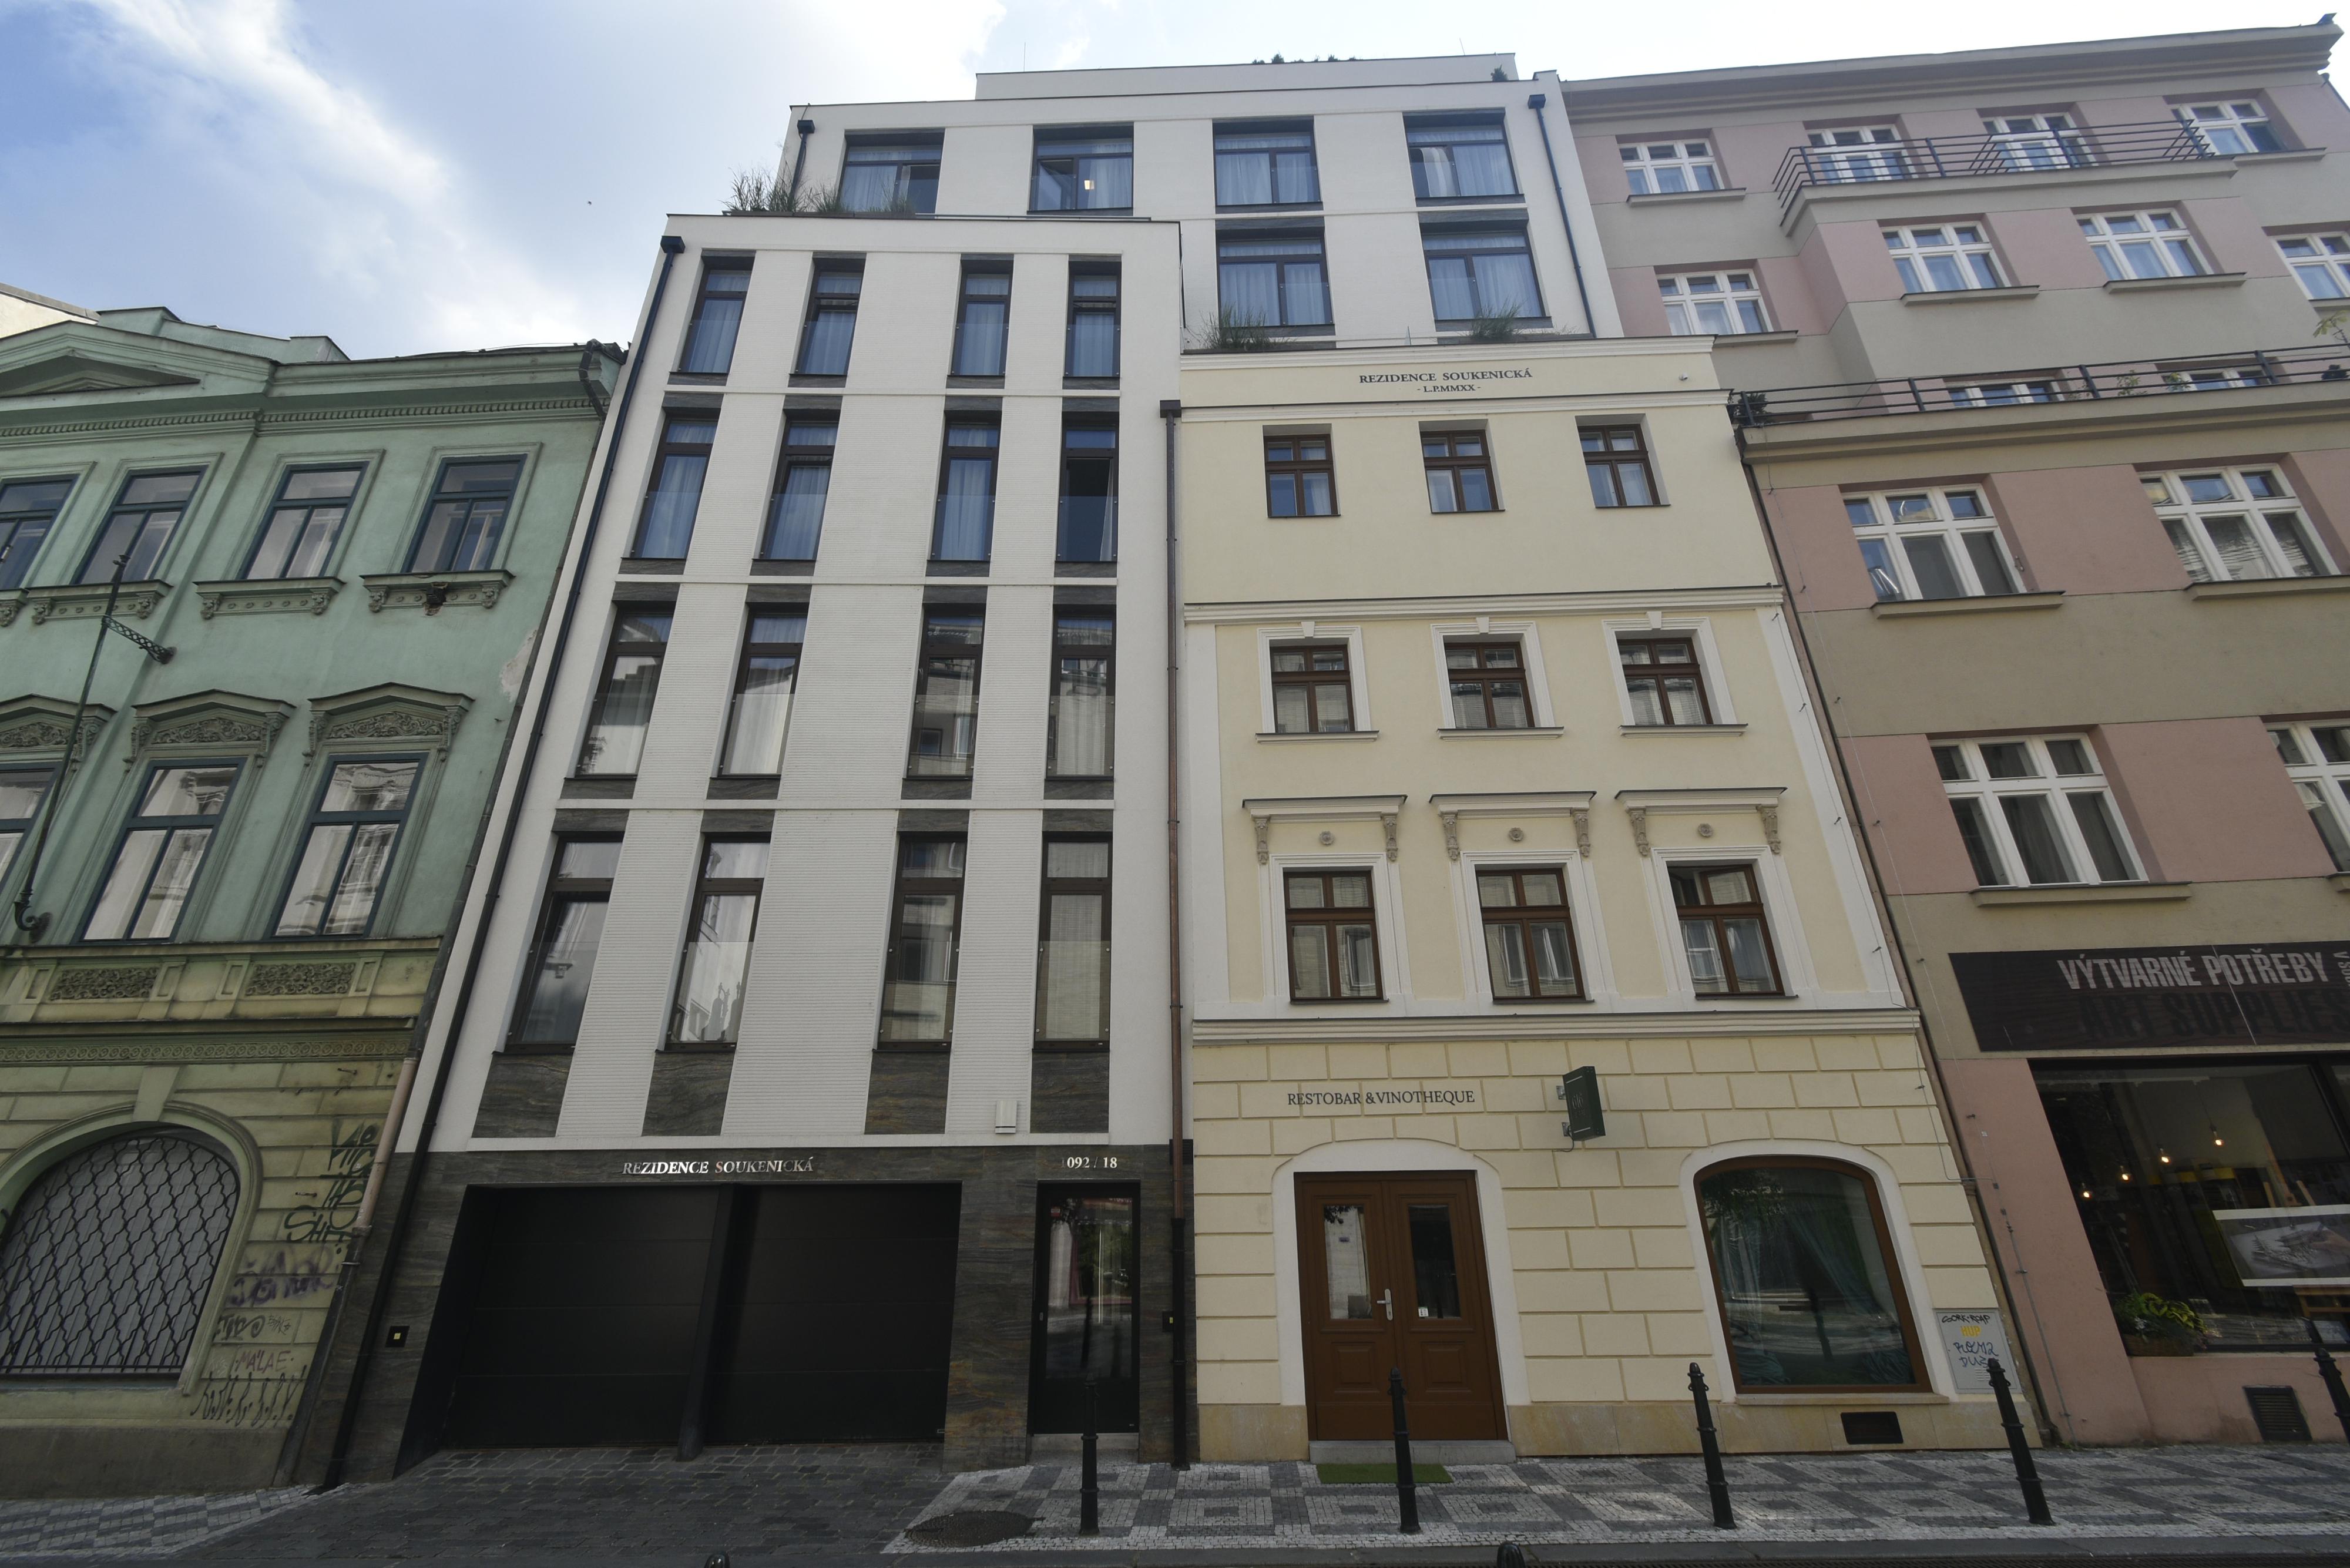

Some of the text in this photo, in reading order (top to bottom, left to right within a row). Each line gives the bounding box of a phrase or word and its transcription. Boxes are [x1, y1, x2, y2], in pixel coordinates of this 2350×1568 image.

[1359, 368, 1533, 384] REZIDENCE SOUKENICKÁ
[2057, 948, 2329, 989] VÝTVARNÉ POTŘEBY
[1287, 1092, 1362, 1106] RESTOBAR
[622, 1156, 814, 1175] REZIDENCE SOUKENICKÁ
[1103, 1157, 1118, 1169] 18
